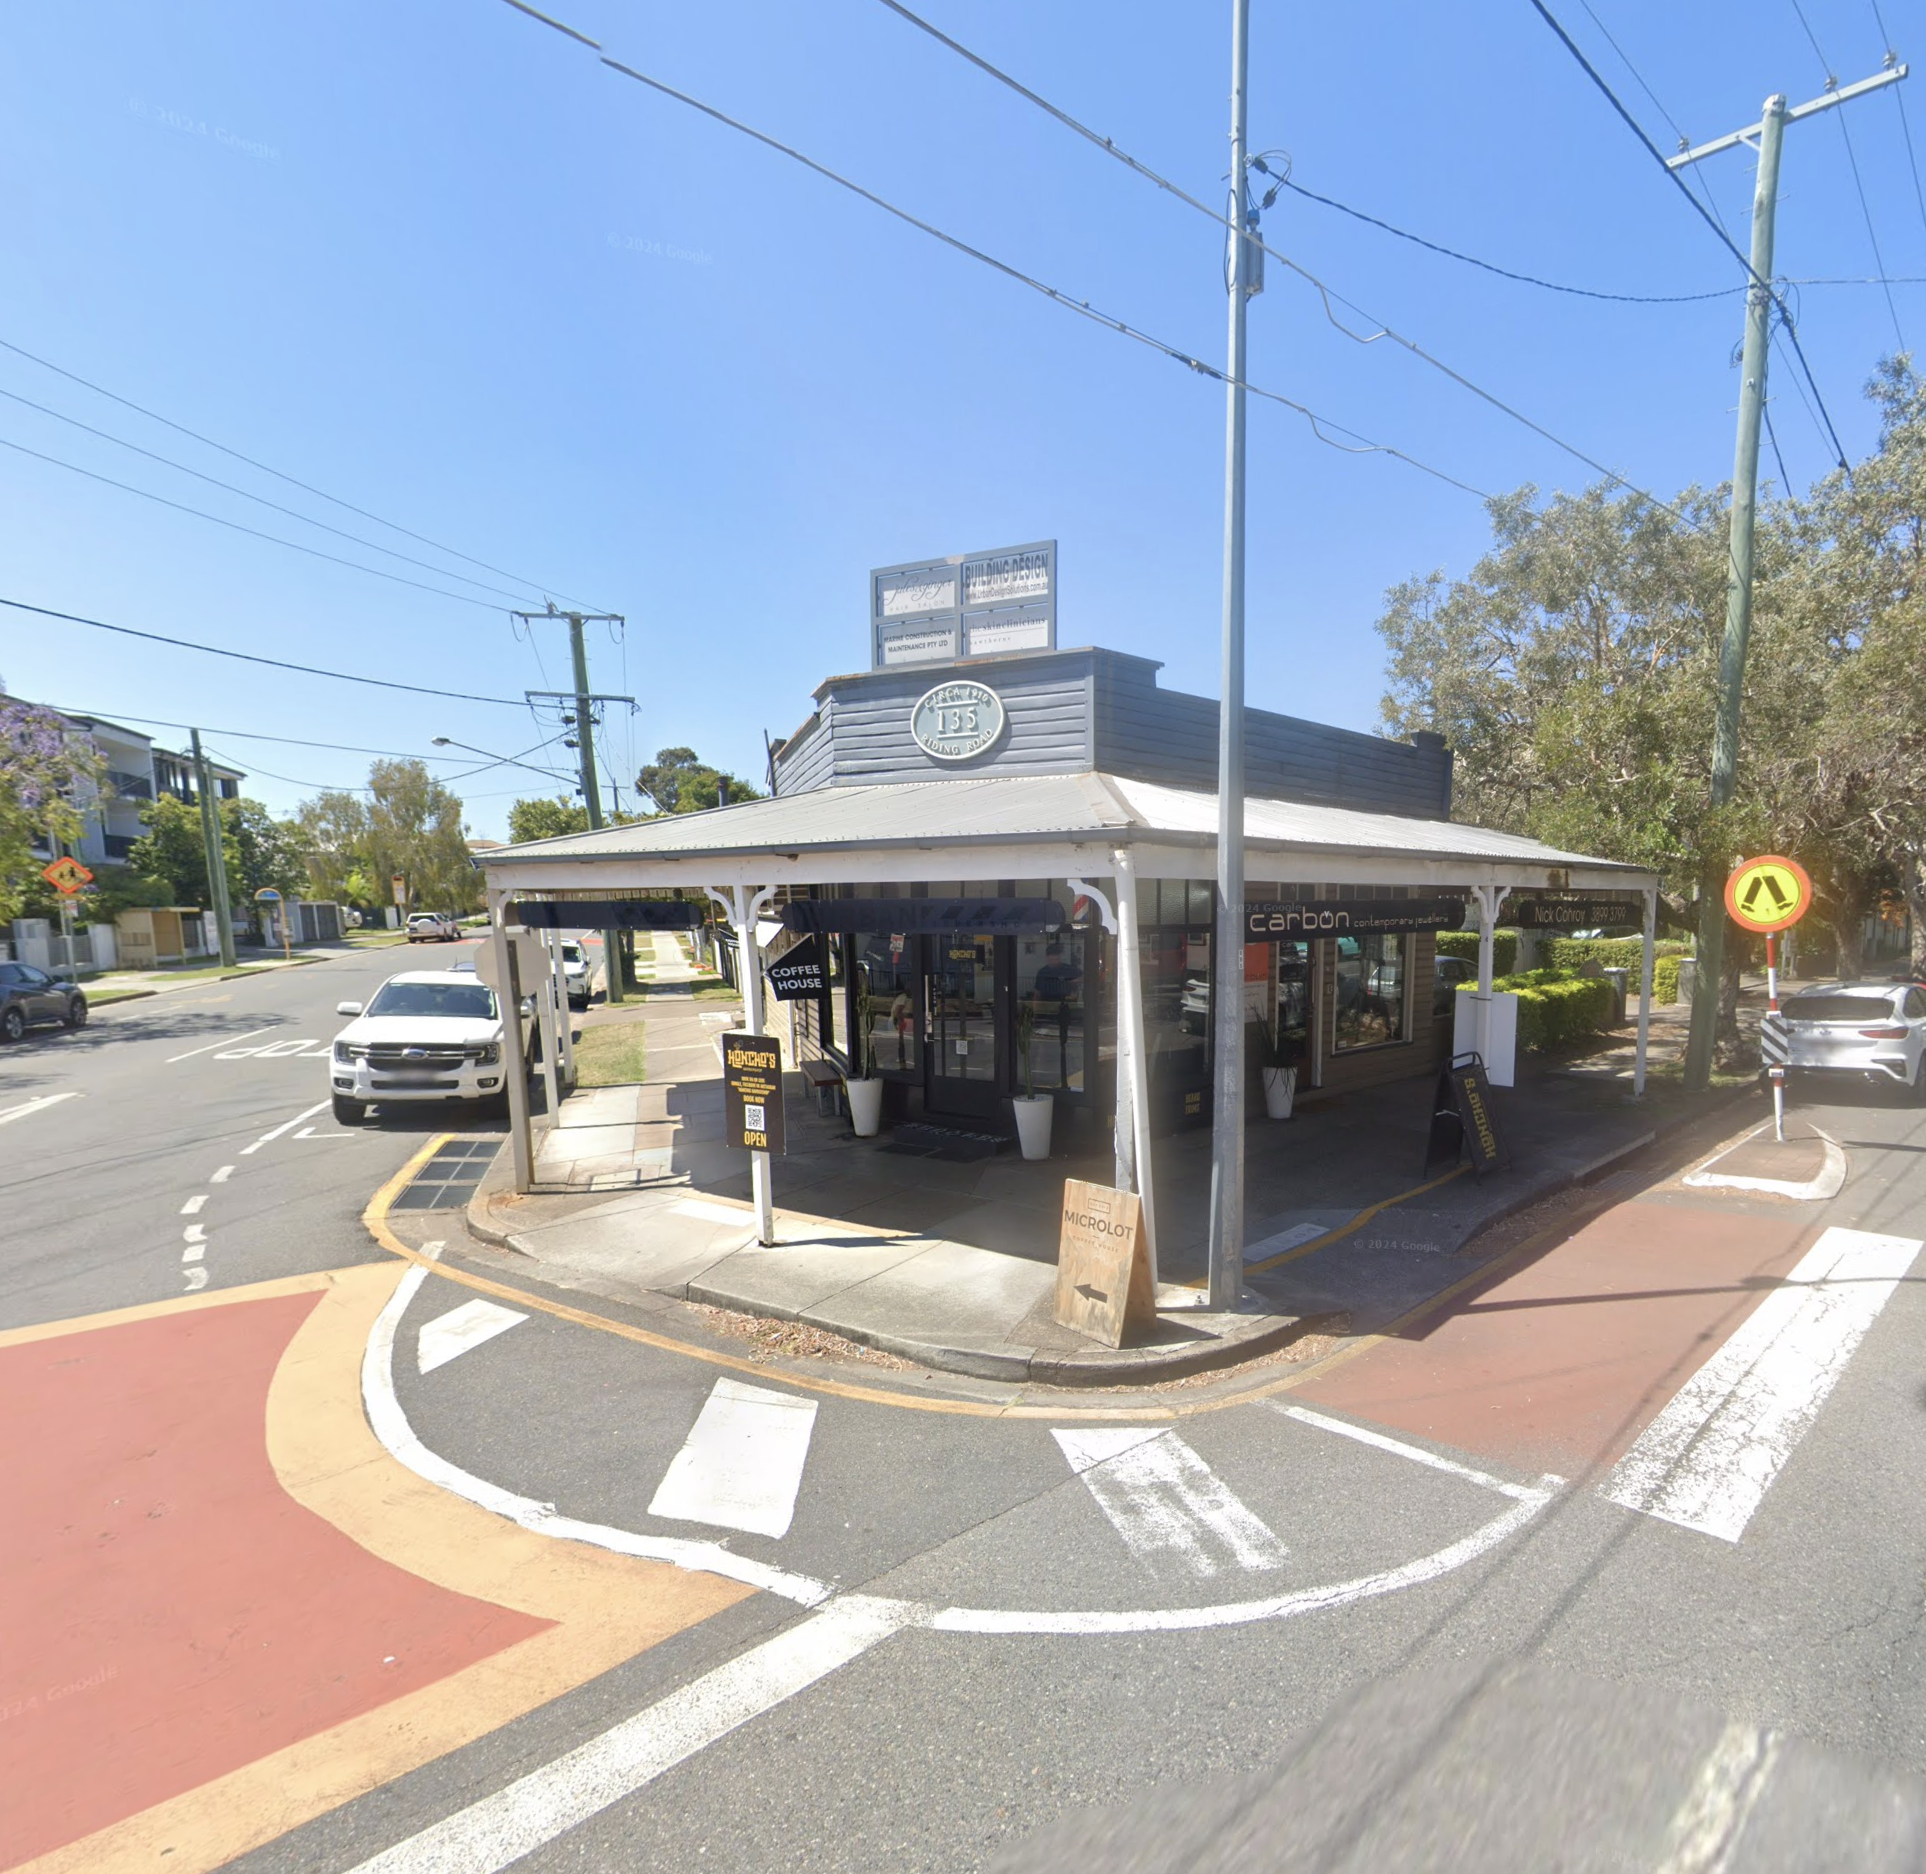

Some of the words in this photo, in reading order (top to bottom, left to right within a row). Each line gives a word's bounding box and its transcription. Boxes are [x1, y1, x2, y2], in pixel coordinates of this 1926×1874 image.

[965, 560, 1010, 589] BUILDING
[1012, 553, 1048, 582] DESIGN
[883, 634, 904, 643] MARINE
[905, 629, 947, 640] CONSTRUCTION
[888, 642, 926, 652] MAINTENANCE
[924, 687, 960, 708] CIRCA
[966, 686, 989, 702] 1910
[937, 706, 976, 731] 135
[921, 733, 959, 754] RIDING
[966, 728, 993, 751] ROAD
[1249, 906, 1350, 932] carbon
[1353, 914, 1414, 931] contemporary
[1415, 912, 1449, 929] jewellery
[1535, 906, 1554, 923] Nick
[1555, 905, 1586, 924] Conroy
[1590, 906, 1609, 923] 3899
[1610, 906, 1626, 922] 3799
[771, 964, 821, 978] COFFEE
[777, 978, 823, 991] HOUSE
[212, 1039, 331, 1059] TOP
[727, 1049, 776, 1069] HONCHO'S
[744, 1131, 767, 1148] OPEN
[1064, 1209, 1134, 1240] MICROLOT
[1072, 1235, 1096, 1247] COFFEE
[1098, 1242, 1119, 1253] HOUSE
